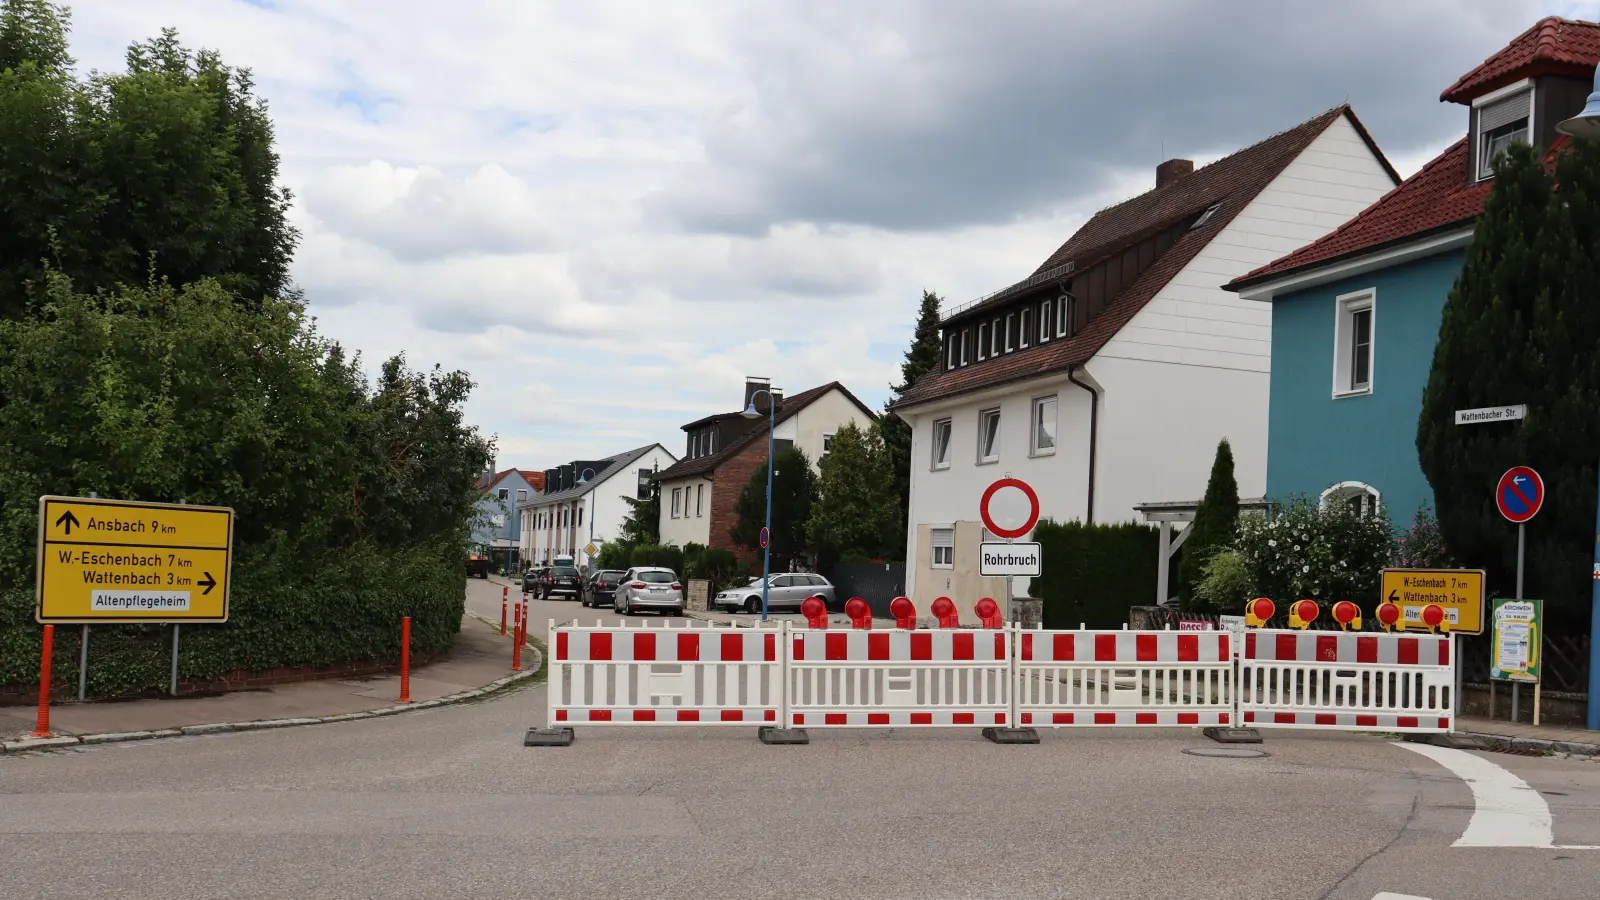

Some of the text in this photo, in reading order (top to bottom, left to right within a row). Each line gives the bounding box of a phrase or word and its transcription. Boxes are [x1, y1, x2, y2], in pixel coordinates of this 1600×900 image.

[1461, 408, 1517, 421] Wattenbacher Str.
[87, 517, 176, 534] Ansbach 9 km
[59, 550, 192, 568] W.-Eschenbach 7 km
[984, 553, 1037, 566] Rohrbruch
[83, 570, 191, 586] Wattenbach 3 km
[1403, 576, 1468, 589] W.-Eschenbach 7 km
[96, 594, 186, 609] Altenpflegeheim
[1403, 592, 1468, 604] Wattenbach 3 km
